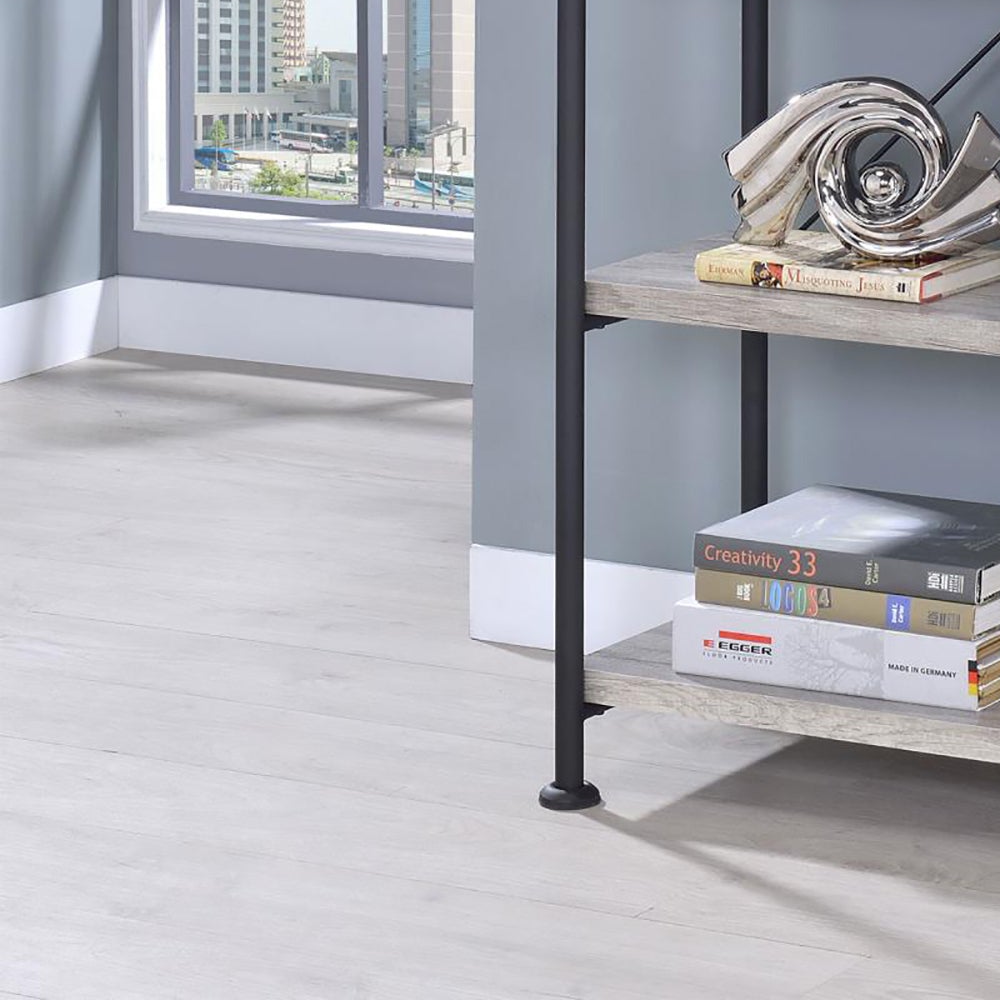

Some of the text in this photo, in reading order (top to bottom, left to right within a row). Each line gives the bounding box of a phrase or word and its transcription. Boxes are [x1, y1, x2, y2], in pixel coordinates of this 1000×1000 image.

[704, 544, 818, 577] Creativity 33
[718, 641, 773, 657] EGGER
[887, 663, 957, 679] MADE IN GERMANY
